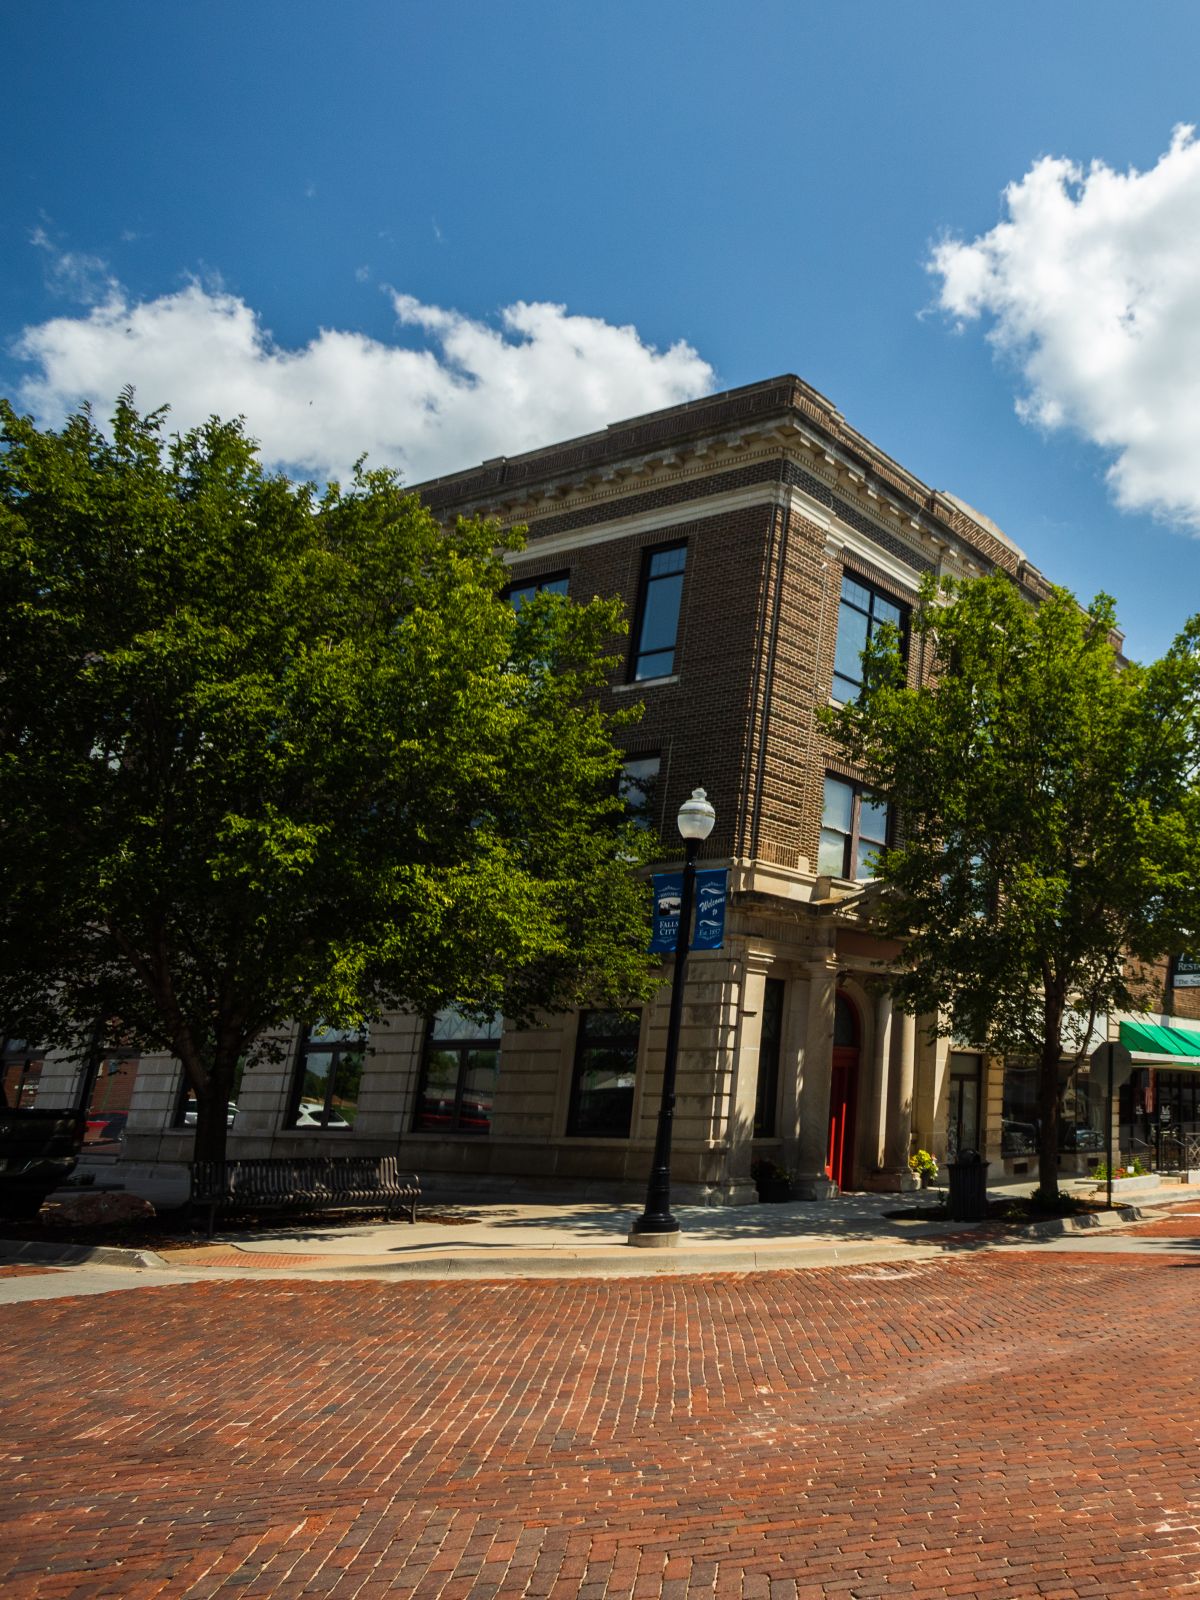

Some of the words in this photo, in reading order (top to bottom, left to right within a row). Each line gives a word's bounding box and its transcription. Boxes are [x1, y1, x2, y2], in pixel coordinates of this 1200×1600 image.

[699, 896, 725, 912] Welcome
[659, 920, 679, 929] FALLS
[659, 928, 677, 936] CITY
